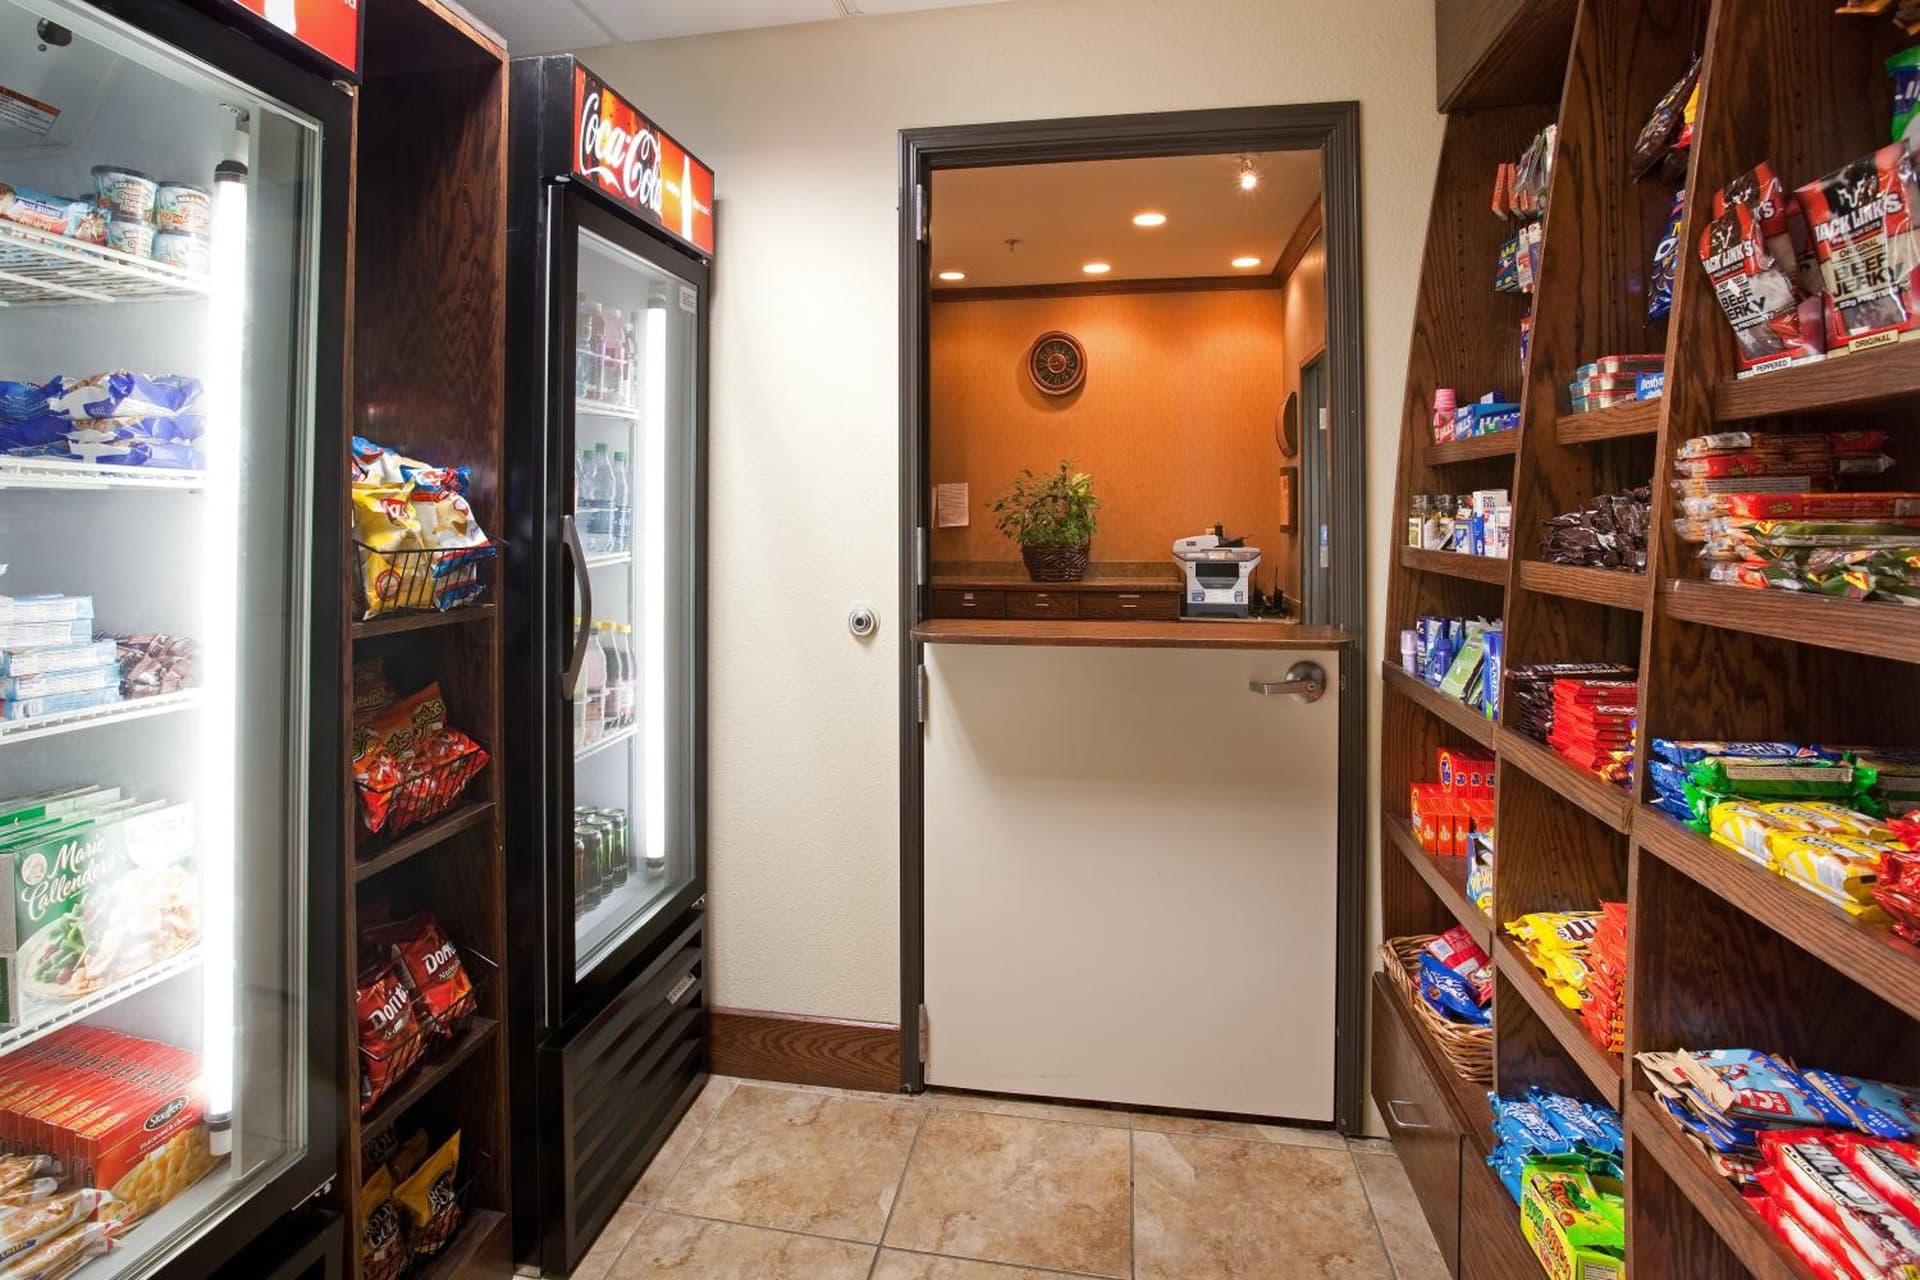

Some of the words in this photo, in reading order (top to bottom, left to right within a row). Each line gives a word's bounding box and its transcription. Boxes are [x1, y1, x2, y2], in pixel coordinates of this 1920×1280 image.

[578, 92, 662, 214] Coca-Cola
[1852, 193, 1903, 227] LINK'S
[1834, 253, 1887, 282] BEEF
[1727, 297, 1766, 321] ERKY
[1855, 333, 1891, 349] ORIGINAL
[1756, 360, 1788, 373] PEPPERED
[48, 834, 106, 878] Marie
